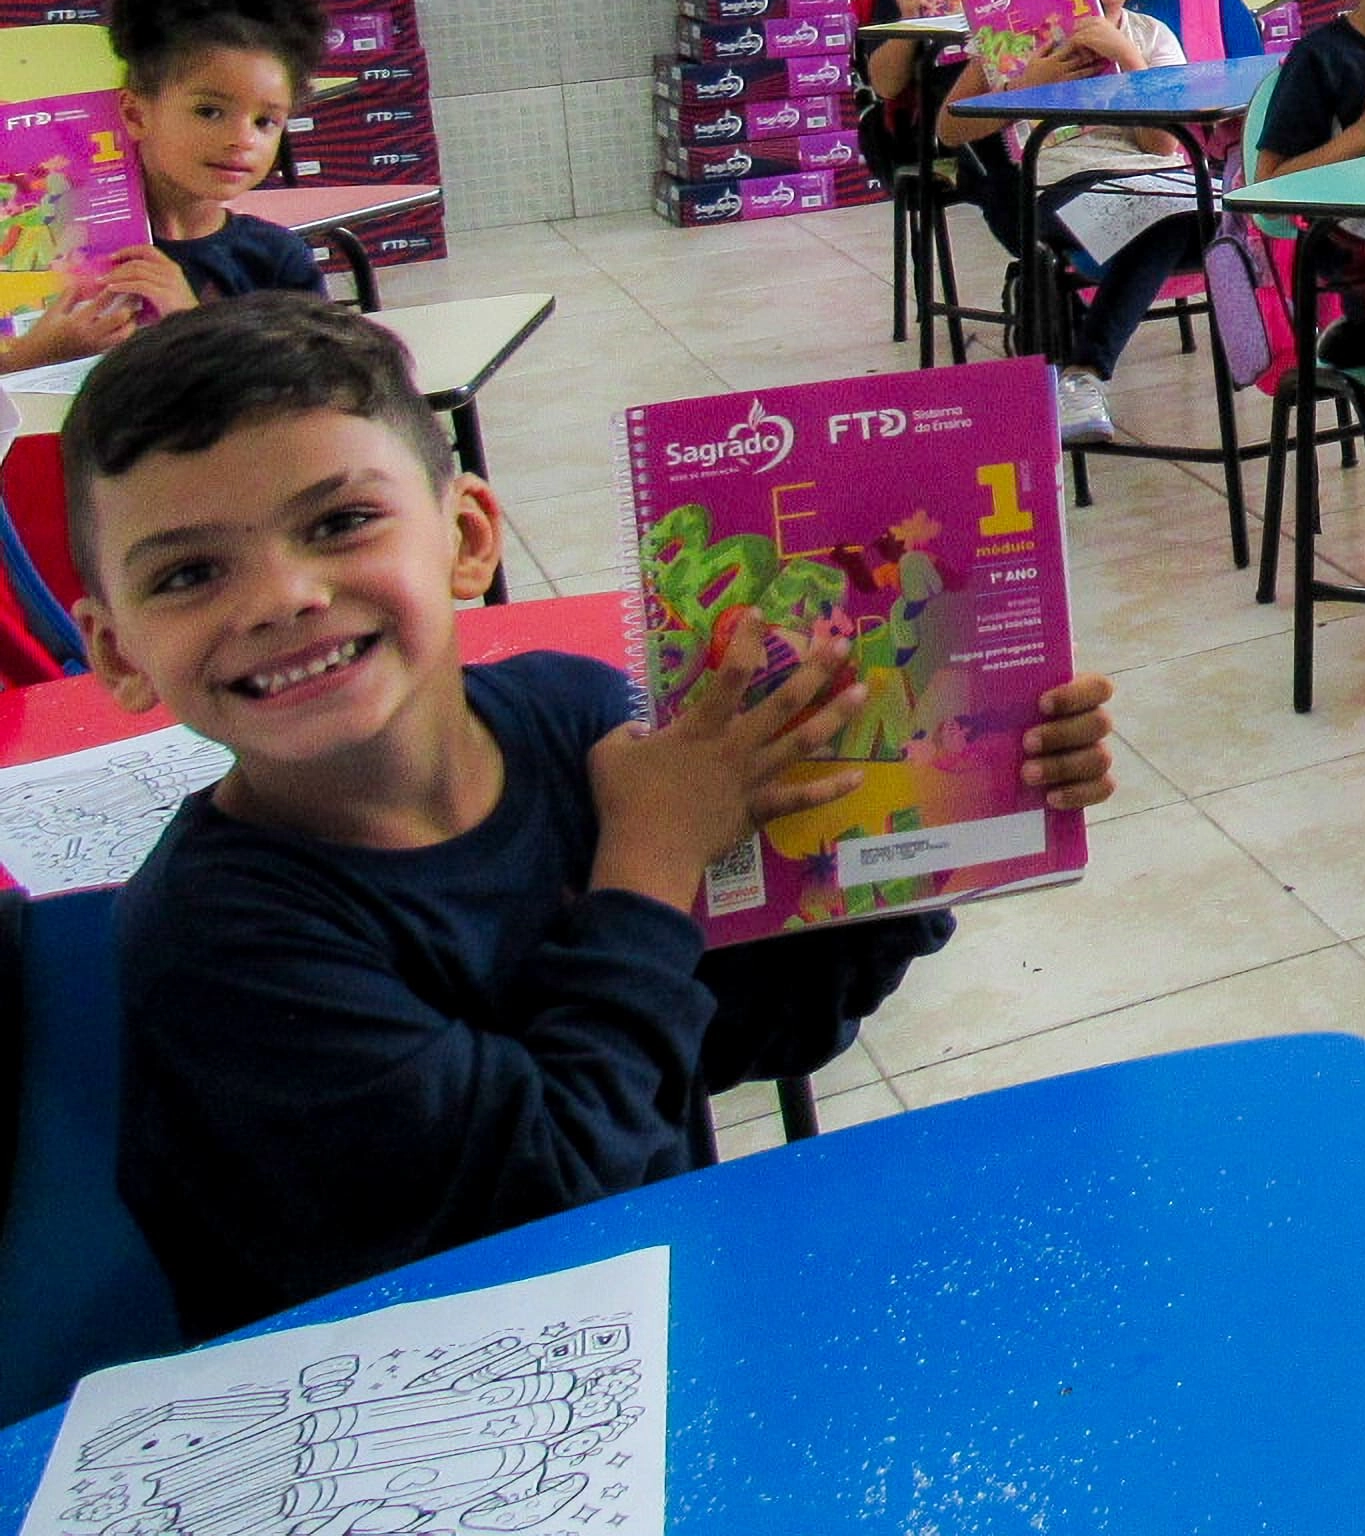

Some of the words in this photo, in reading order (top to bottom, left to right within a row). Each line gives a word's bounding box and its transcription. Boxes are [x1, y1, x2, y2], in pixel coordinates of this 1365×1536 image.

[7, 112, 52, 132] FTD
[90, 131, 126, 164] 1
[665, 430, 781, 467] Sagrado
[828, 408, 907, 445] FTD
[976, 463, 1034, 536] 1
[976, 541, 1035, 558] módulo
[1005, 567, 1038, 582] ANO
